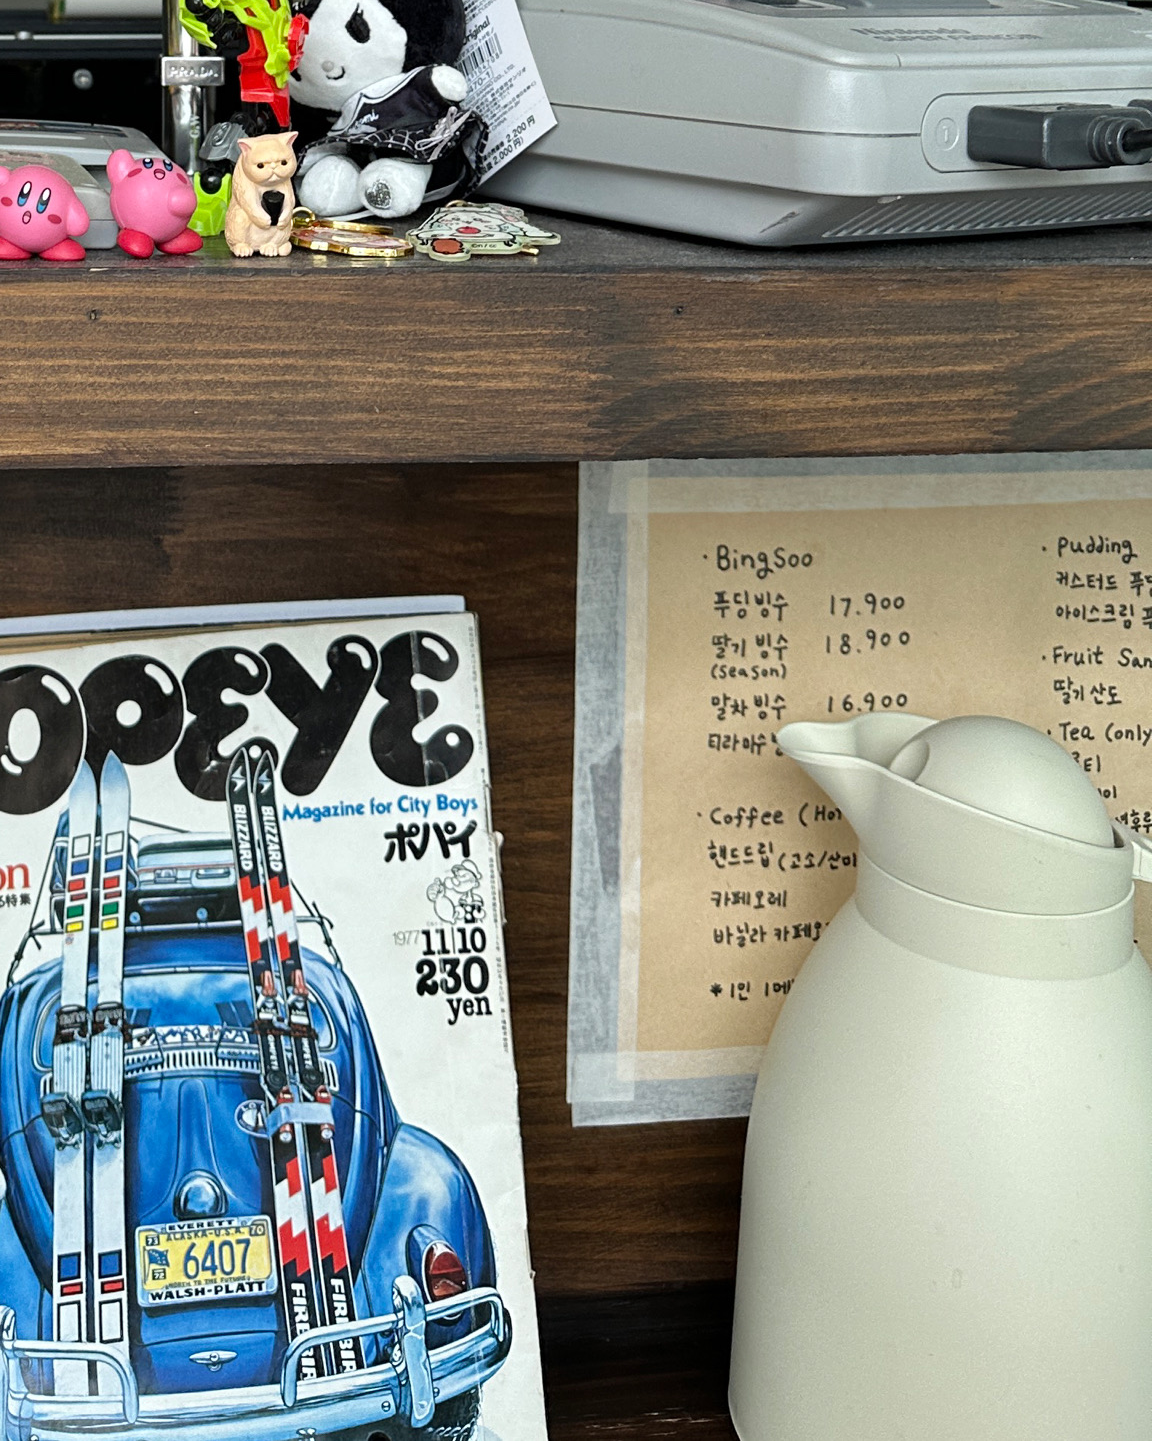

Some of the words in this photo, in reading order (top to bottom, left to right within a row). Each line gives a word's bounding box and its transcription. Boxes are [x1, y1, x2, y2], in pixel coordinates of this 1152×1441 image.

[830, 592, 905, 617] 17.900
[1055, 603, 1135, 630] 아이스크림
[825, 629, 910, 655] 18.900
[1052, 645, 1104, 666] Fruit
[1117, 647, 1152, 669] San
[828, 692, 908, 712] 16.900
[1058, 721, 1095, 742] Tea
[282, 800, 365, 822] Magazine
[369, 797, 393, 816] for
[397, 794, 431, 817] City
[436, 793, 479, 817] Boys
[710, 806, 785, 828] Coffee
[233, 803, 254, 871] BLIZZARD
[260, 805, 284, 872] BLIZZARD
[383, 819, 478, 863] ポパイ
[710, 889, 788, 910] 카페오레
[392, 929, 420, 946] 1977
[415, 955, 490, 997] 230
[446, 996, 493, 1026] yen
[168, 1219, 235, 1231] EVERETT
[249, 1224, 265, 1235] 70
[183, 1238, 251, 1279] 6407
[150, 1280, 266, 1301] WALSH-PLATT
